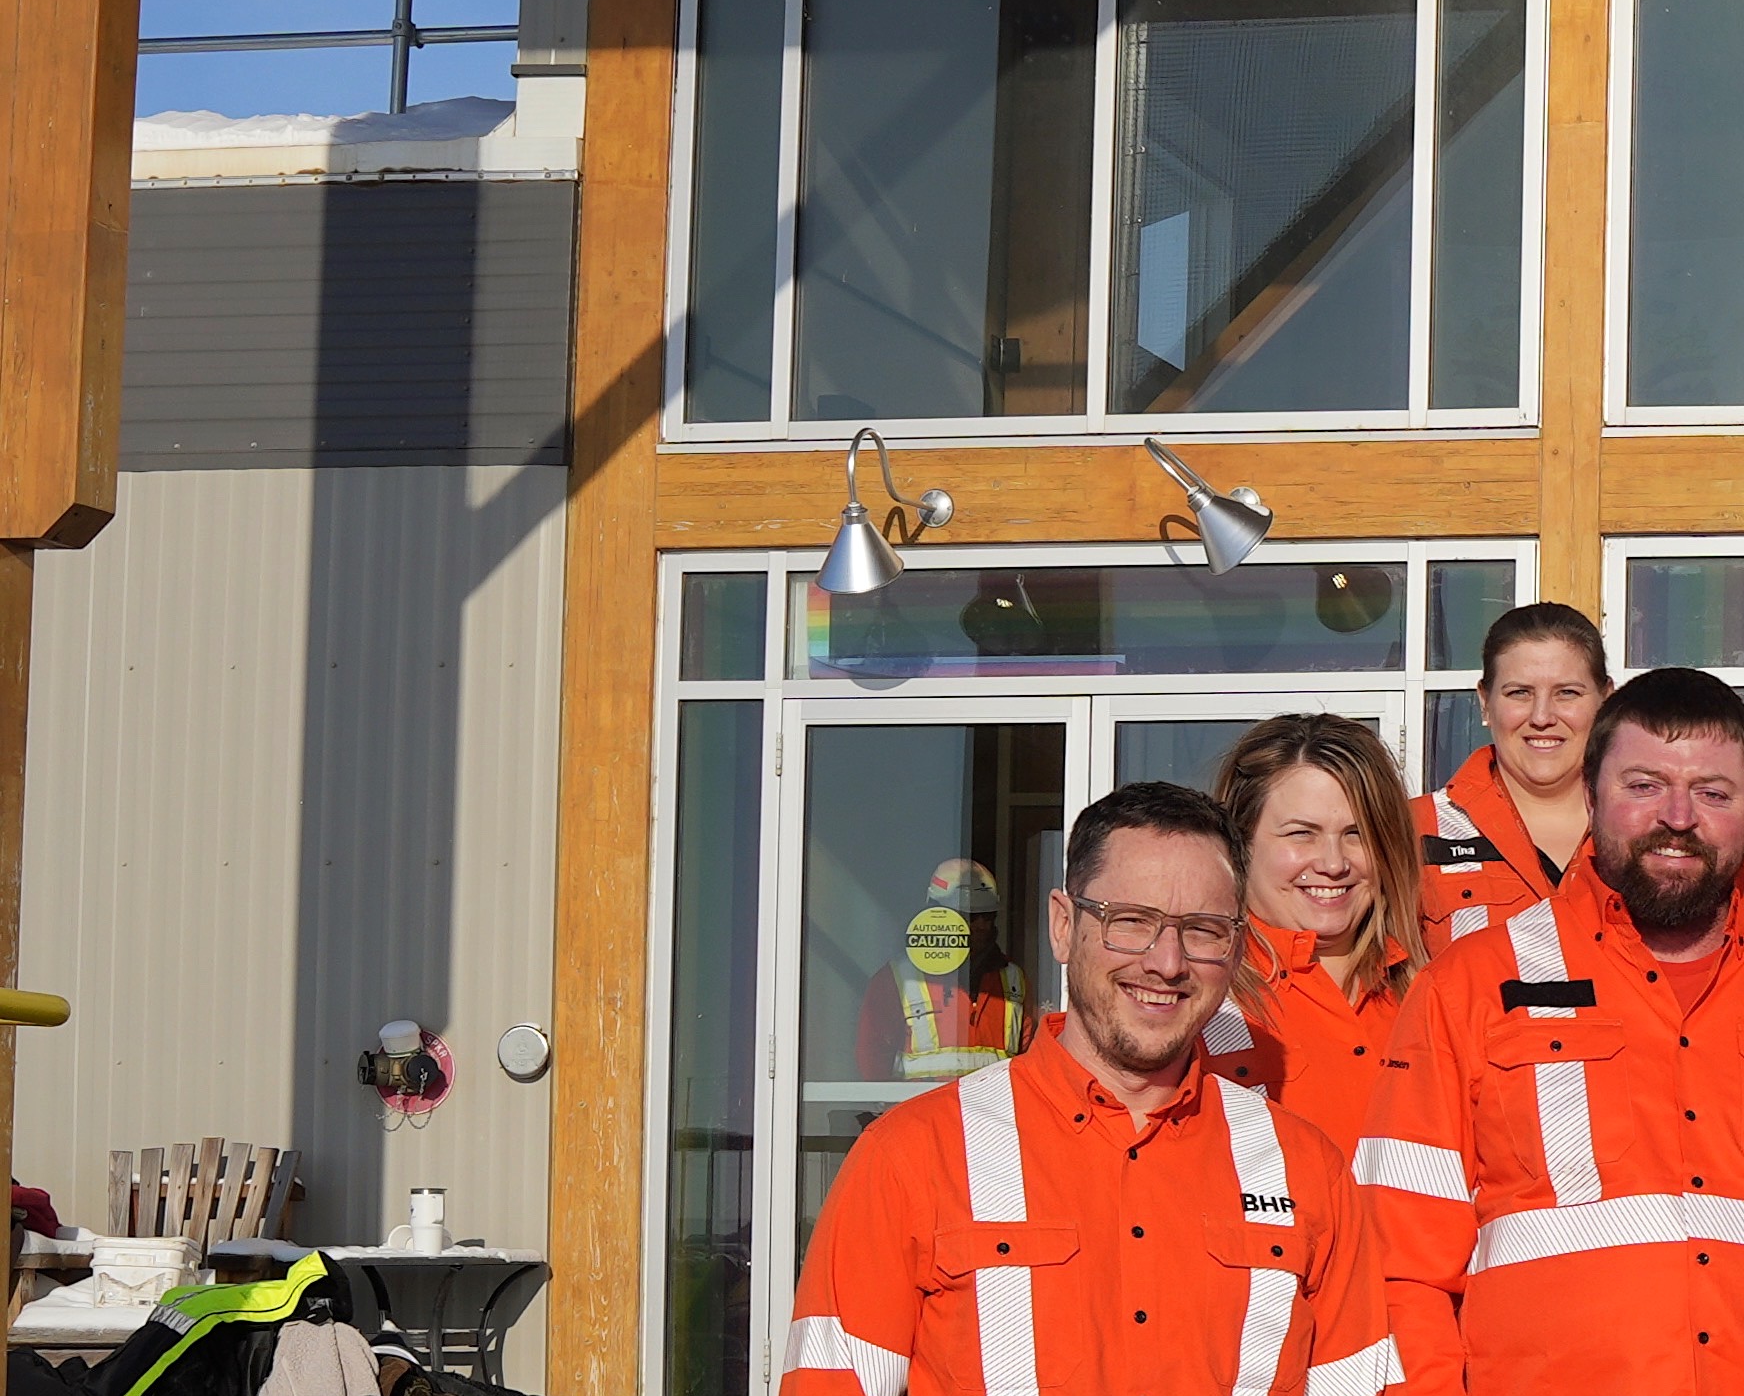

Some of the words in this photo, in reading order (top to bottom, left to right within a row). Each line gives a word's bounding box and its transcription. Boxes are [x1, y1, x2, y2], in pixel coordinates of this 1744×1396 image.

[1449, 845, 1476, 857] Tina
[912, 924, 965, 933] AUTOMATIC
[908, 935, 968, 947] CAUTION
[924, 951, 951, 959] DOOR
[1239, 1193, 1297, 1213] BHP
